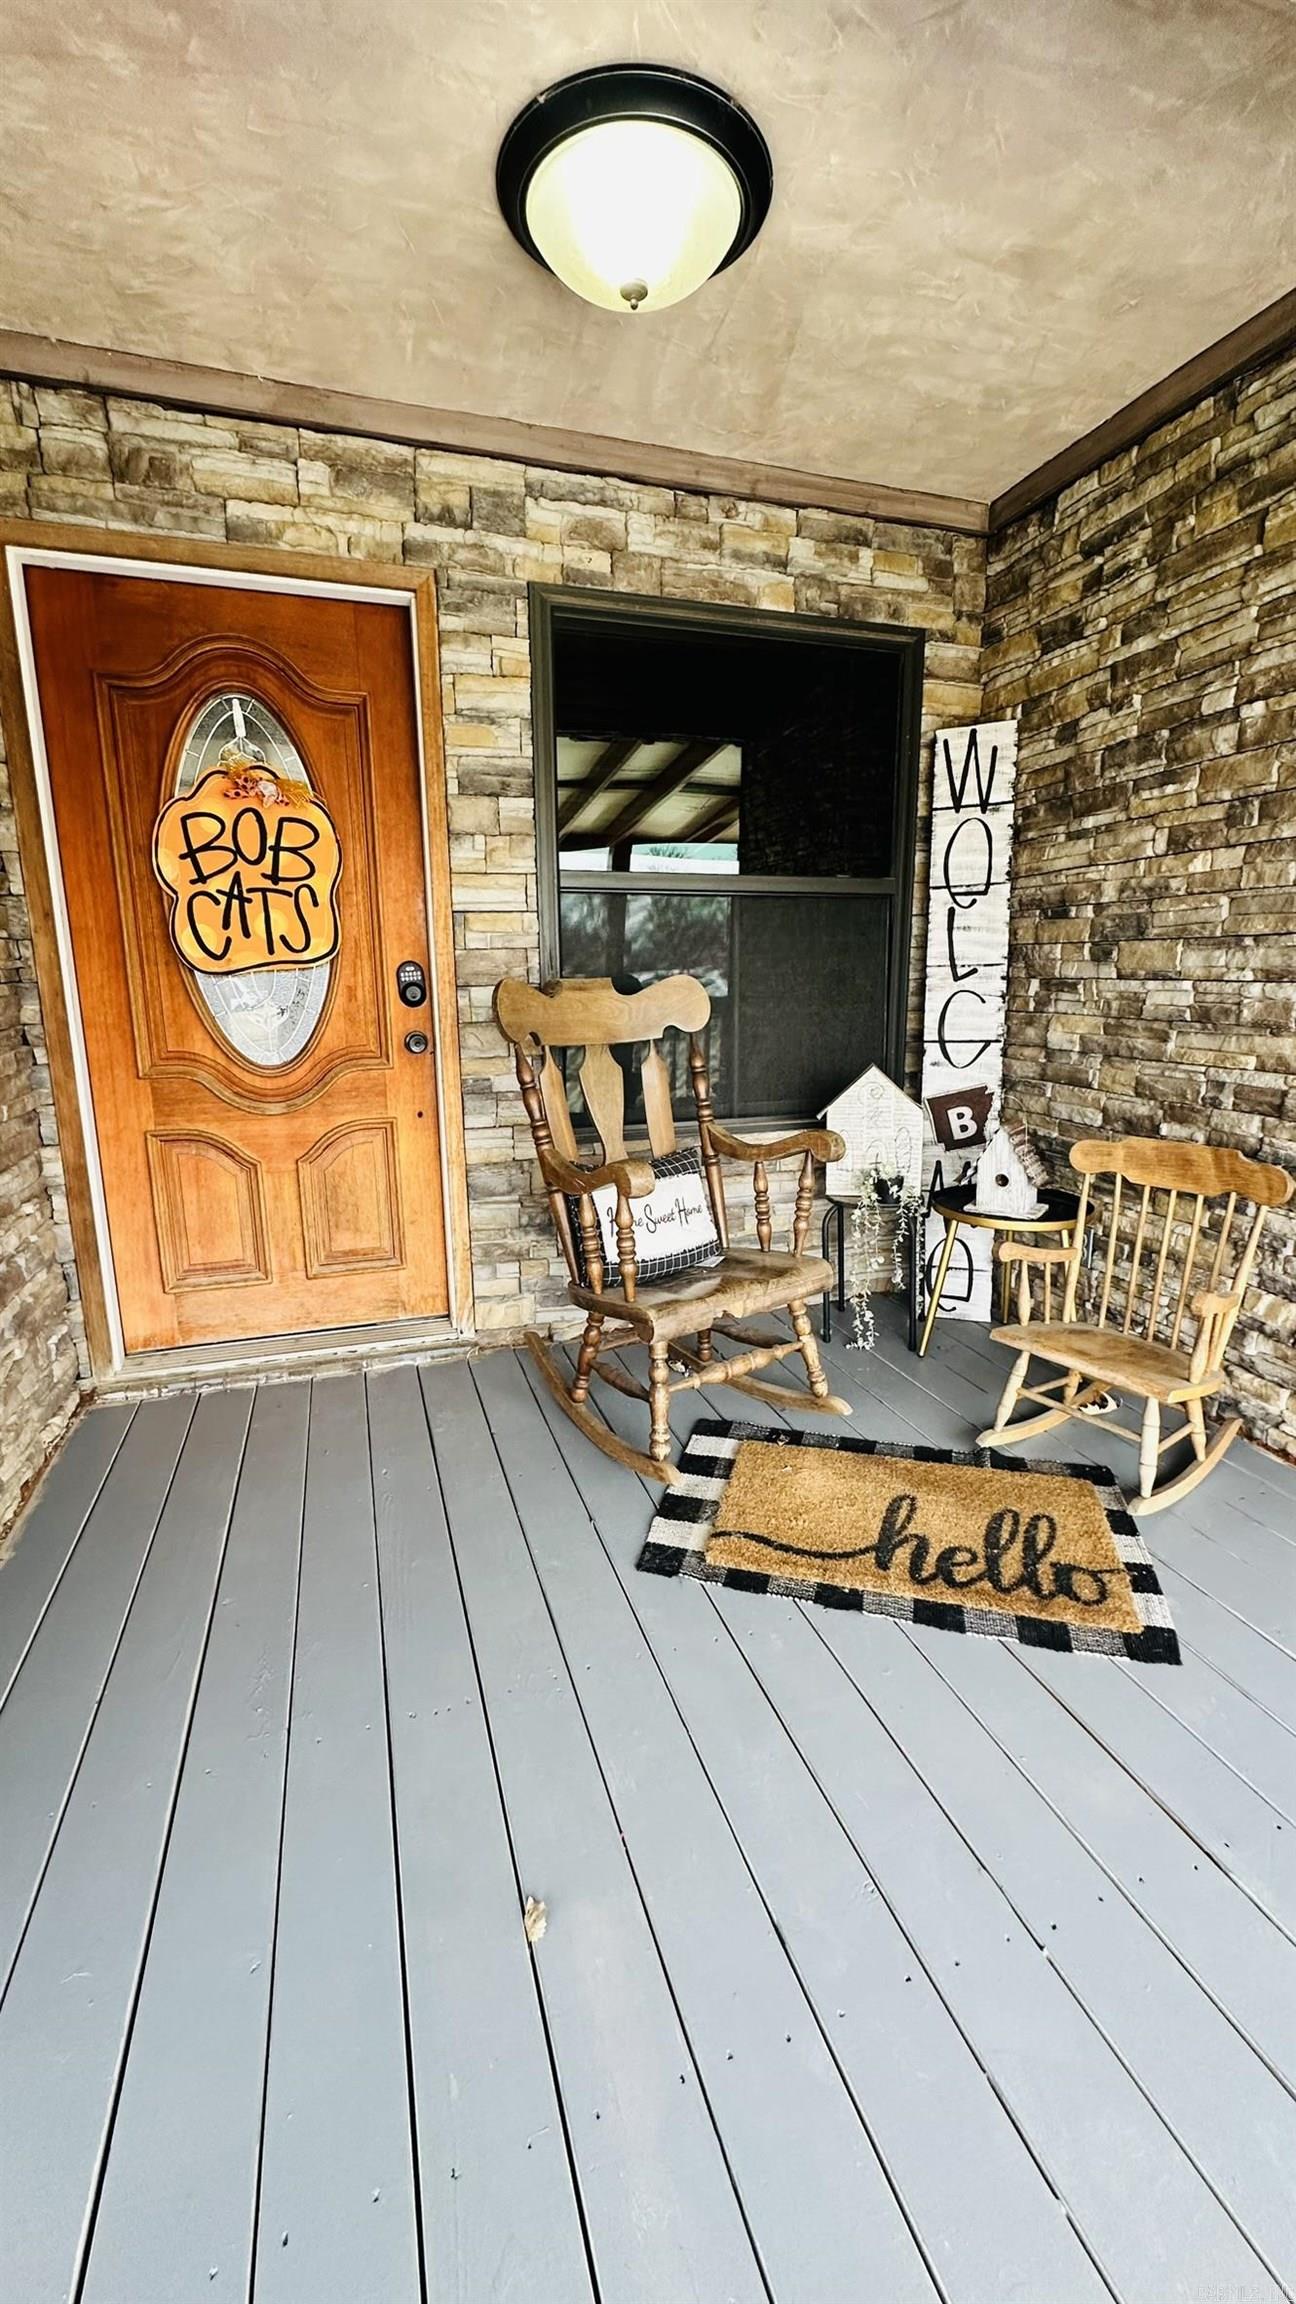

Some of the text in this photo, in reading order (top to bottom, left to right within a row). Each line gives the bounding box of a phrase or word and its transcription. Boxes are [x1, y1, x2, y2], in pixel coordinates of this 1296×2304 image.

[178, 806, 320, 886] BOB
[186, 871, 319, 961] CATS
[643, 1203, 676, 1234] Sweet
[674, 1196, 703, 1228] Home
[710, 1494, 1128, 1606] hello
